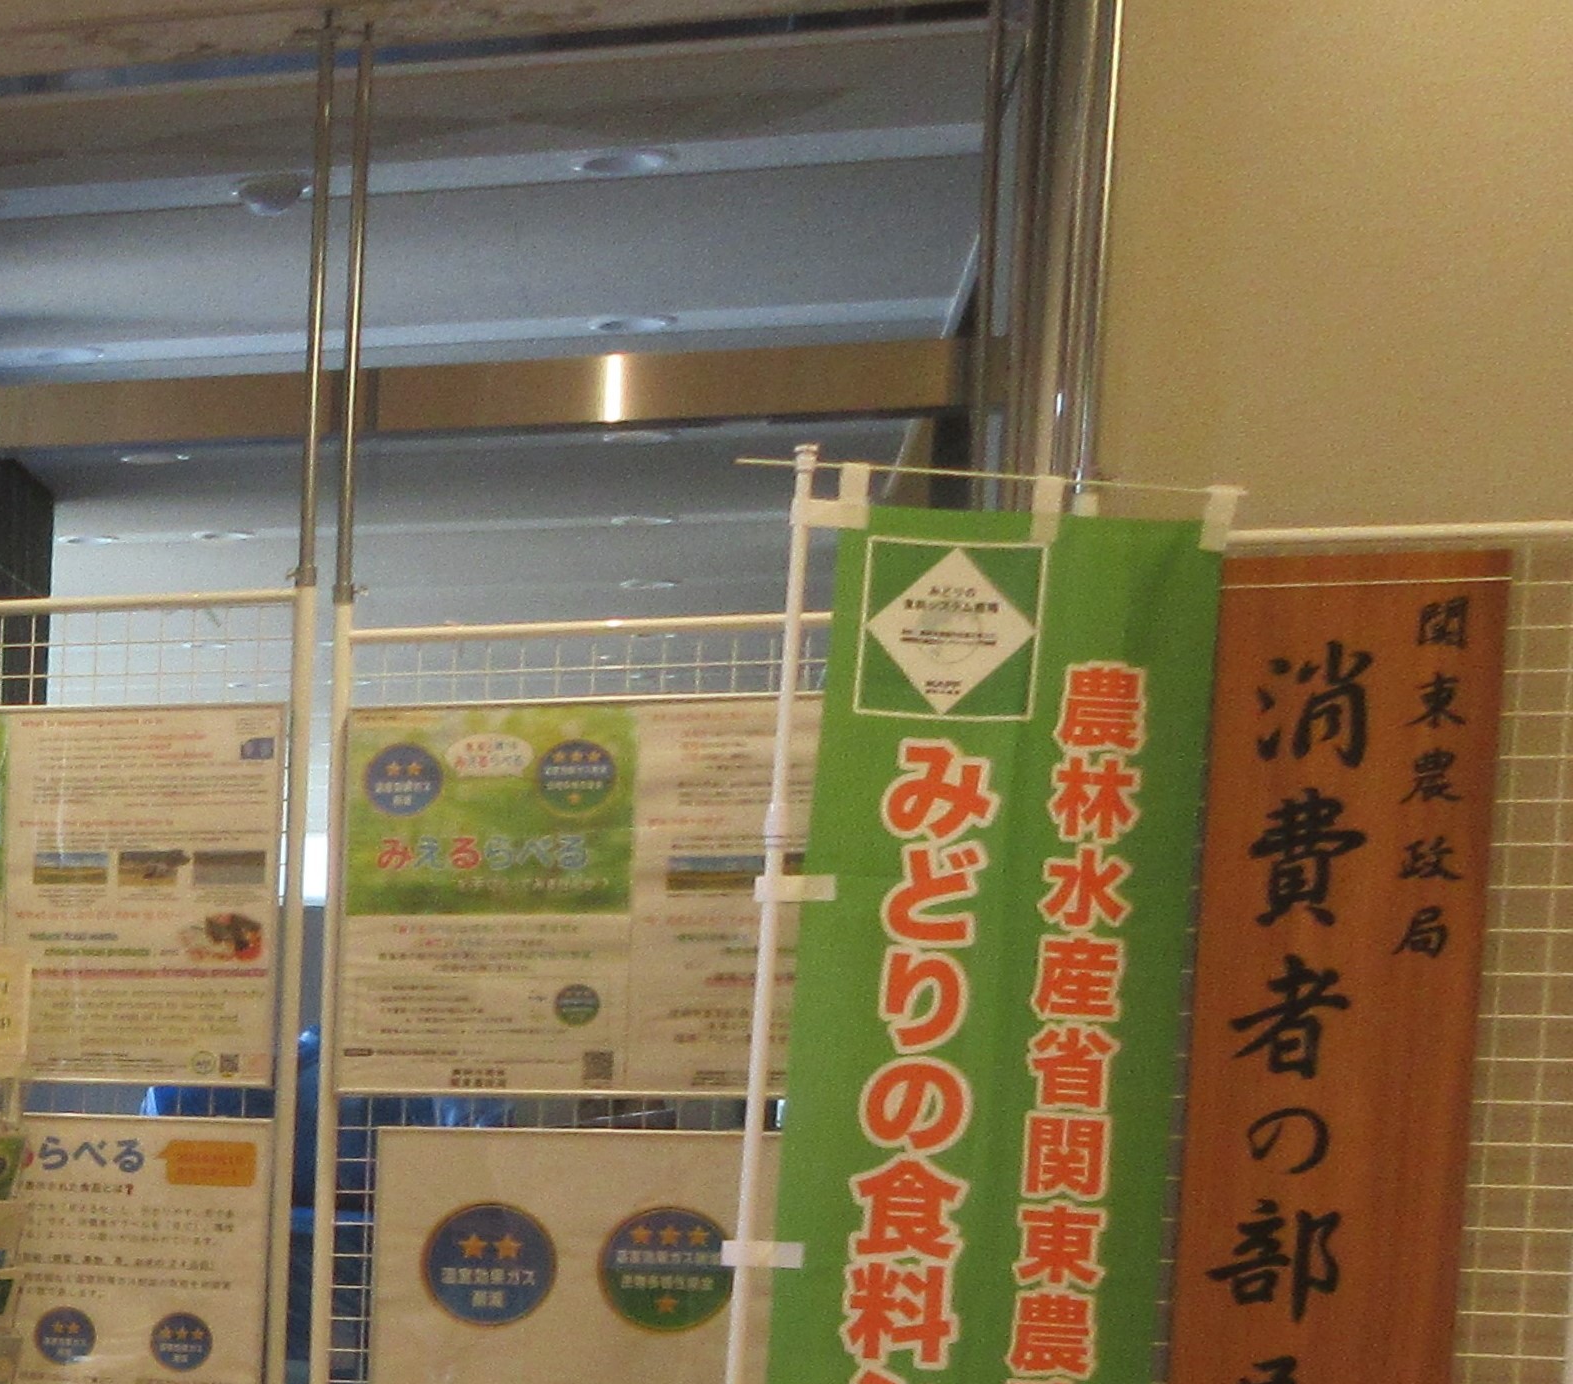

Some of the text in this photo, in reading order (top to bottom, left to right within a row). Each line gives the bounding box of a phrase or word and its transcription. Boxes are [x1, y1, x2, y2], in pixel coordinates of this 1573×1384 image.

[376, 834, 591, 871] みえるらべる
[1390, 595, 1470, 961] 関東農政局
